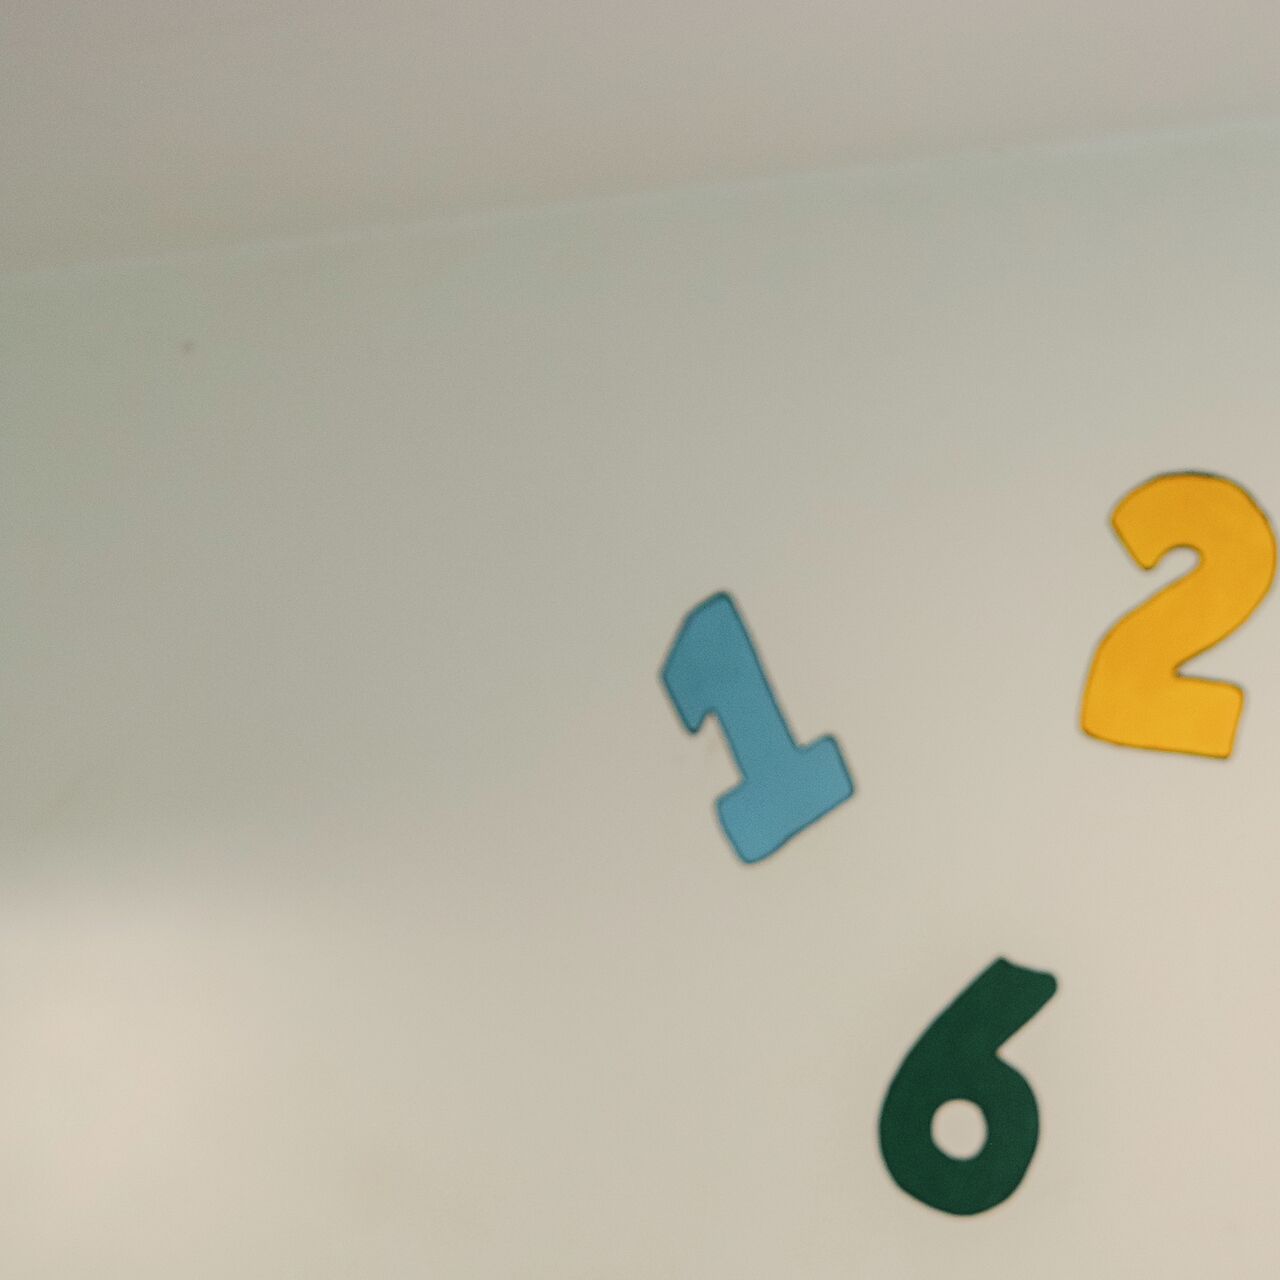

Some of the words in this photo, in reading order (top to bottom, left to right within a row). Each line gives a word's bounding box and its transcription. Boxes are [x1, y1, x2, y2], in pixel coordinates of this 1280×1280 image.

[661, 591, 855, 864] 1
[1079, 469, 1278, 760] 2
[877, 954, 1058, 1217] 6
